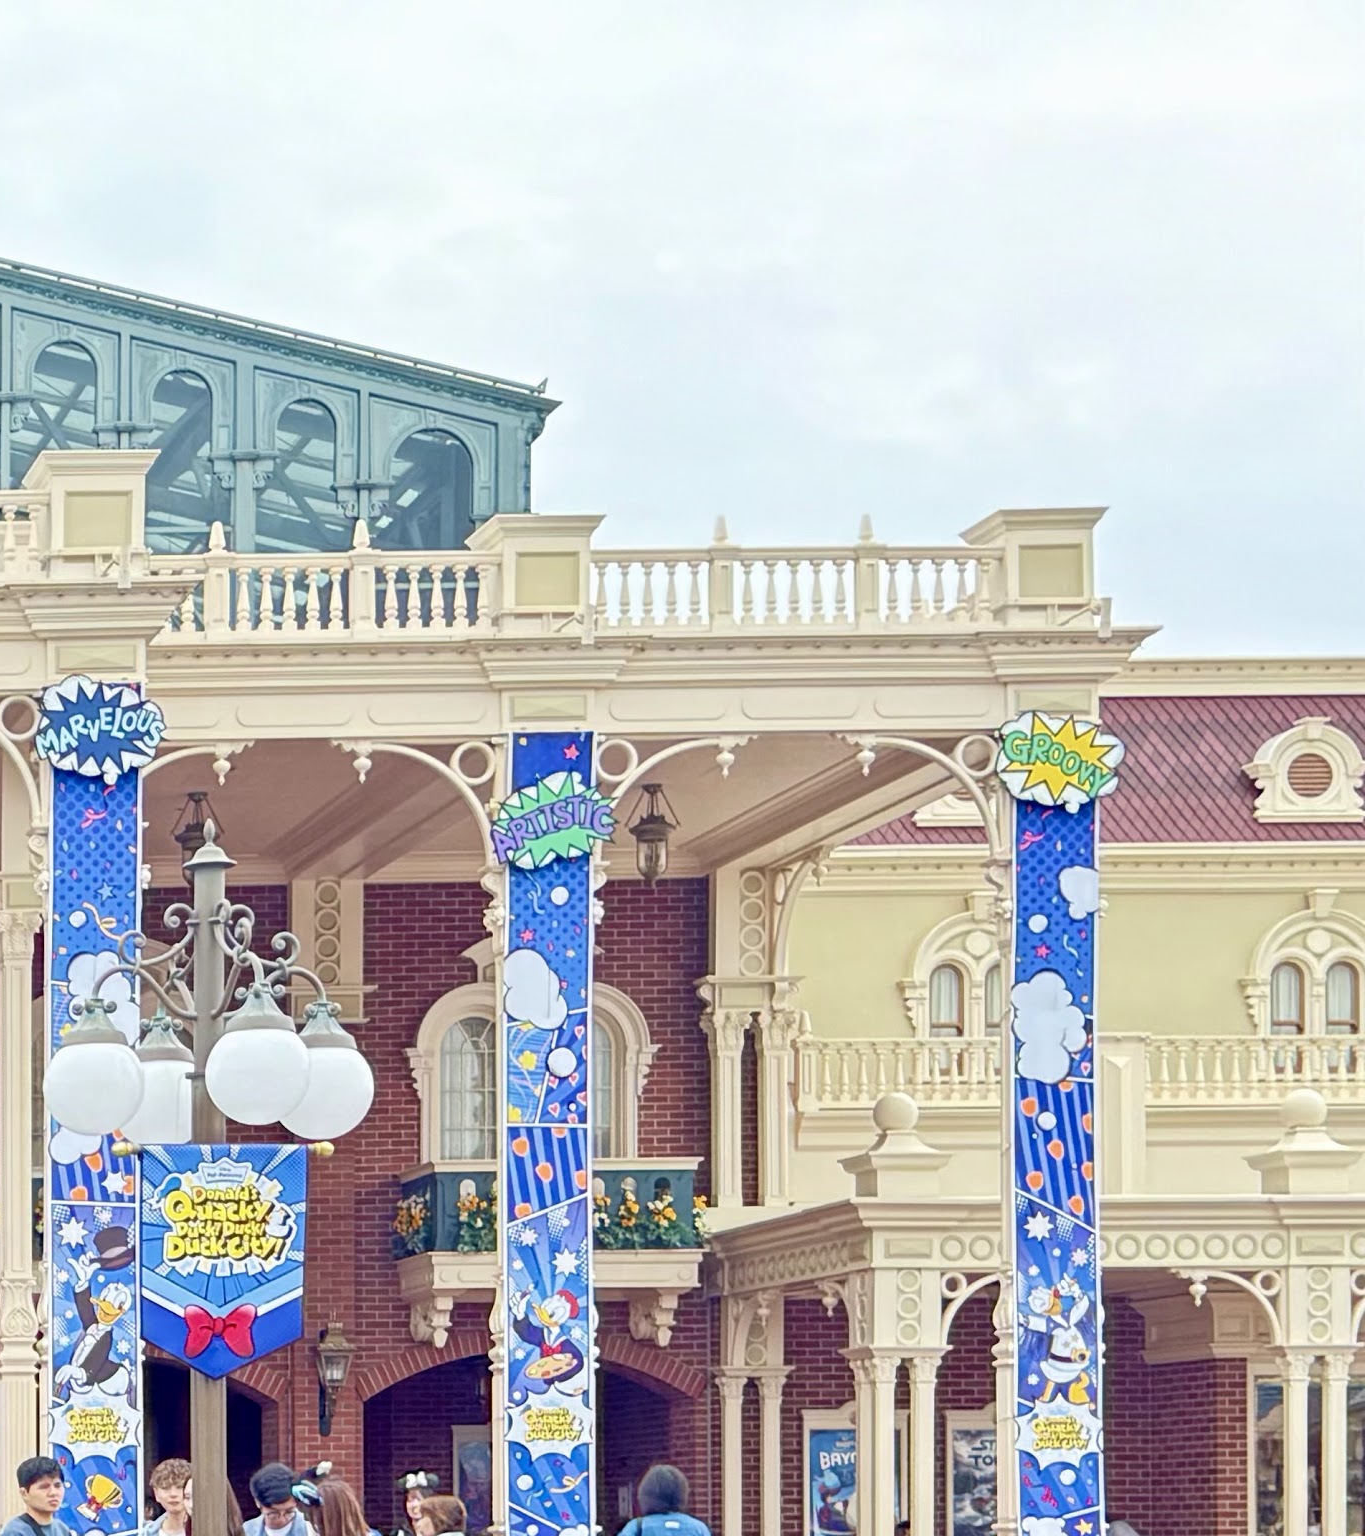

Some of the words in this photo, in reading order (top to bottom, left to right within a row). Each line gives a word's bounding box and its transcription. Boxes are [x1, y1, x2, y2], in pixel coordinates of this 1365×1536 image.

[35, 706, 166, 760] MARVELOUS
[1003, 730, 1113, 798] GROOVY
[491, 795, 615, 864] ARTISTIC
[164, 1190, 272, 1222] Quacky
[192, 1185, 259, 1204] Donald's
[166, 1235, 227, 1260] Duck
[226, 1236, 283, 1261] City!
[968, 1454, 997, 1466] TO
